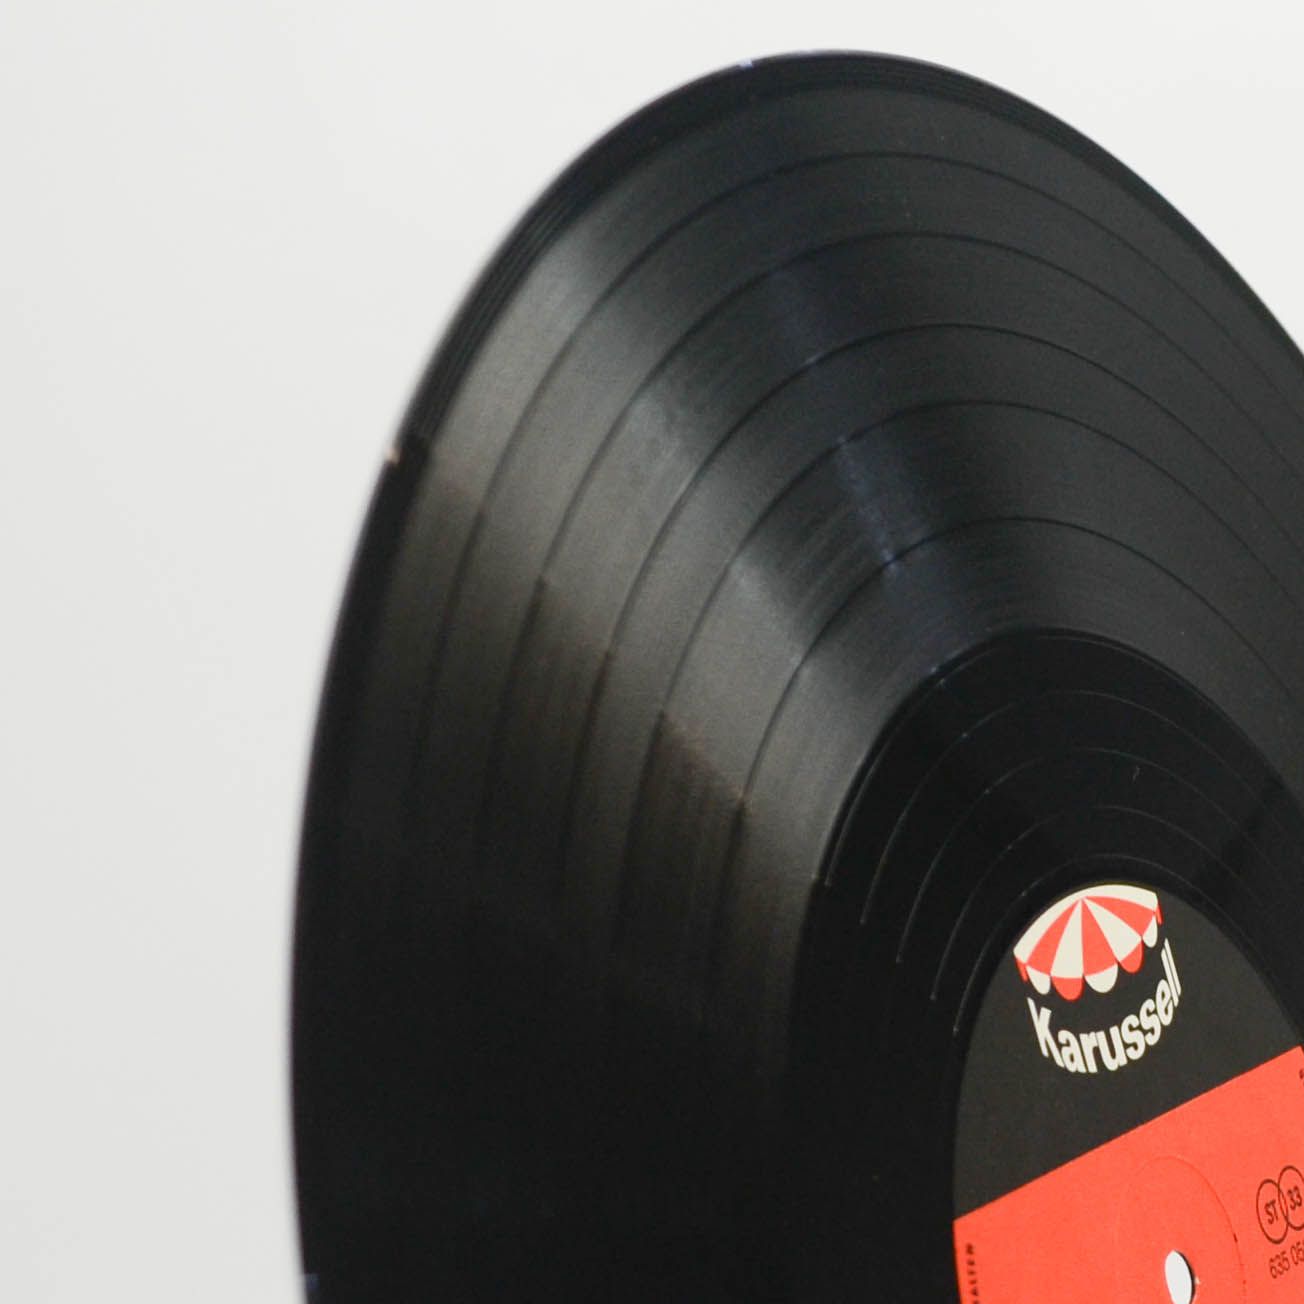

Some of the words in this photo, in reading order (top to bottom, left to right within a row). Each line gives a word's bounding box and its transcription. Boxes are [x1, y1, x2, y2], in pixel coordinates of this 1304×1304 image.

[1027, 938, 1181, 1074] Karussell
[1287, 1185, 1302, 1211] 33
[1264, 1199, 1278, 1225] ST
[1269, 1251, 1290, 1279] 635
